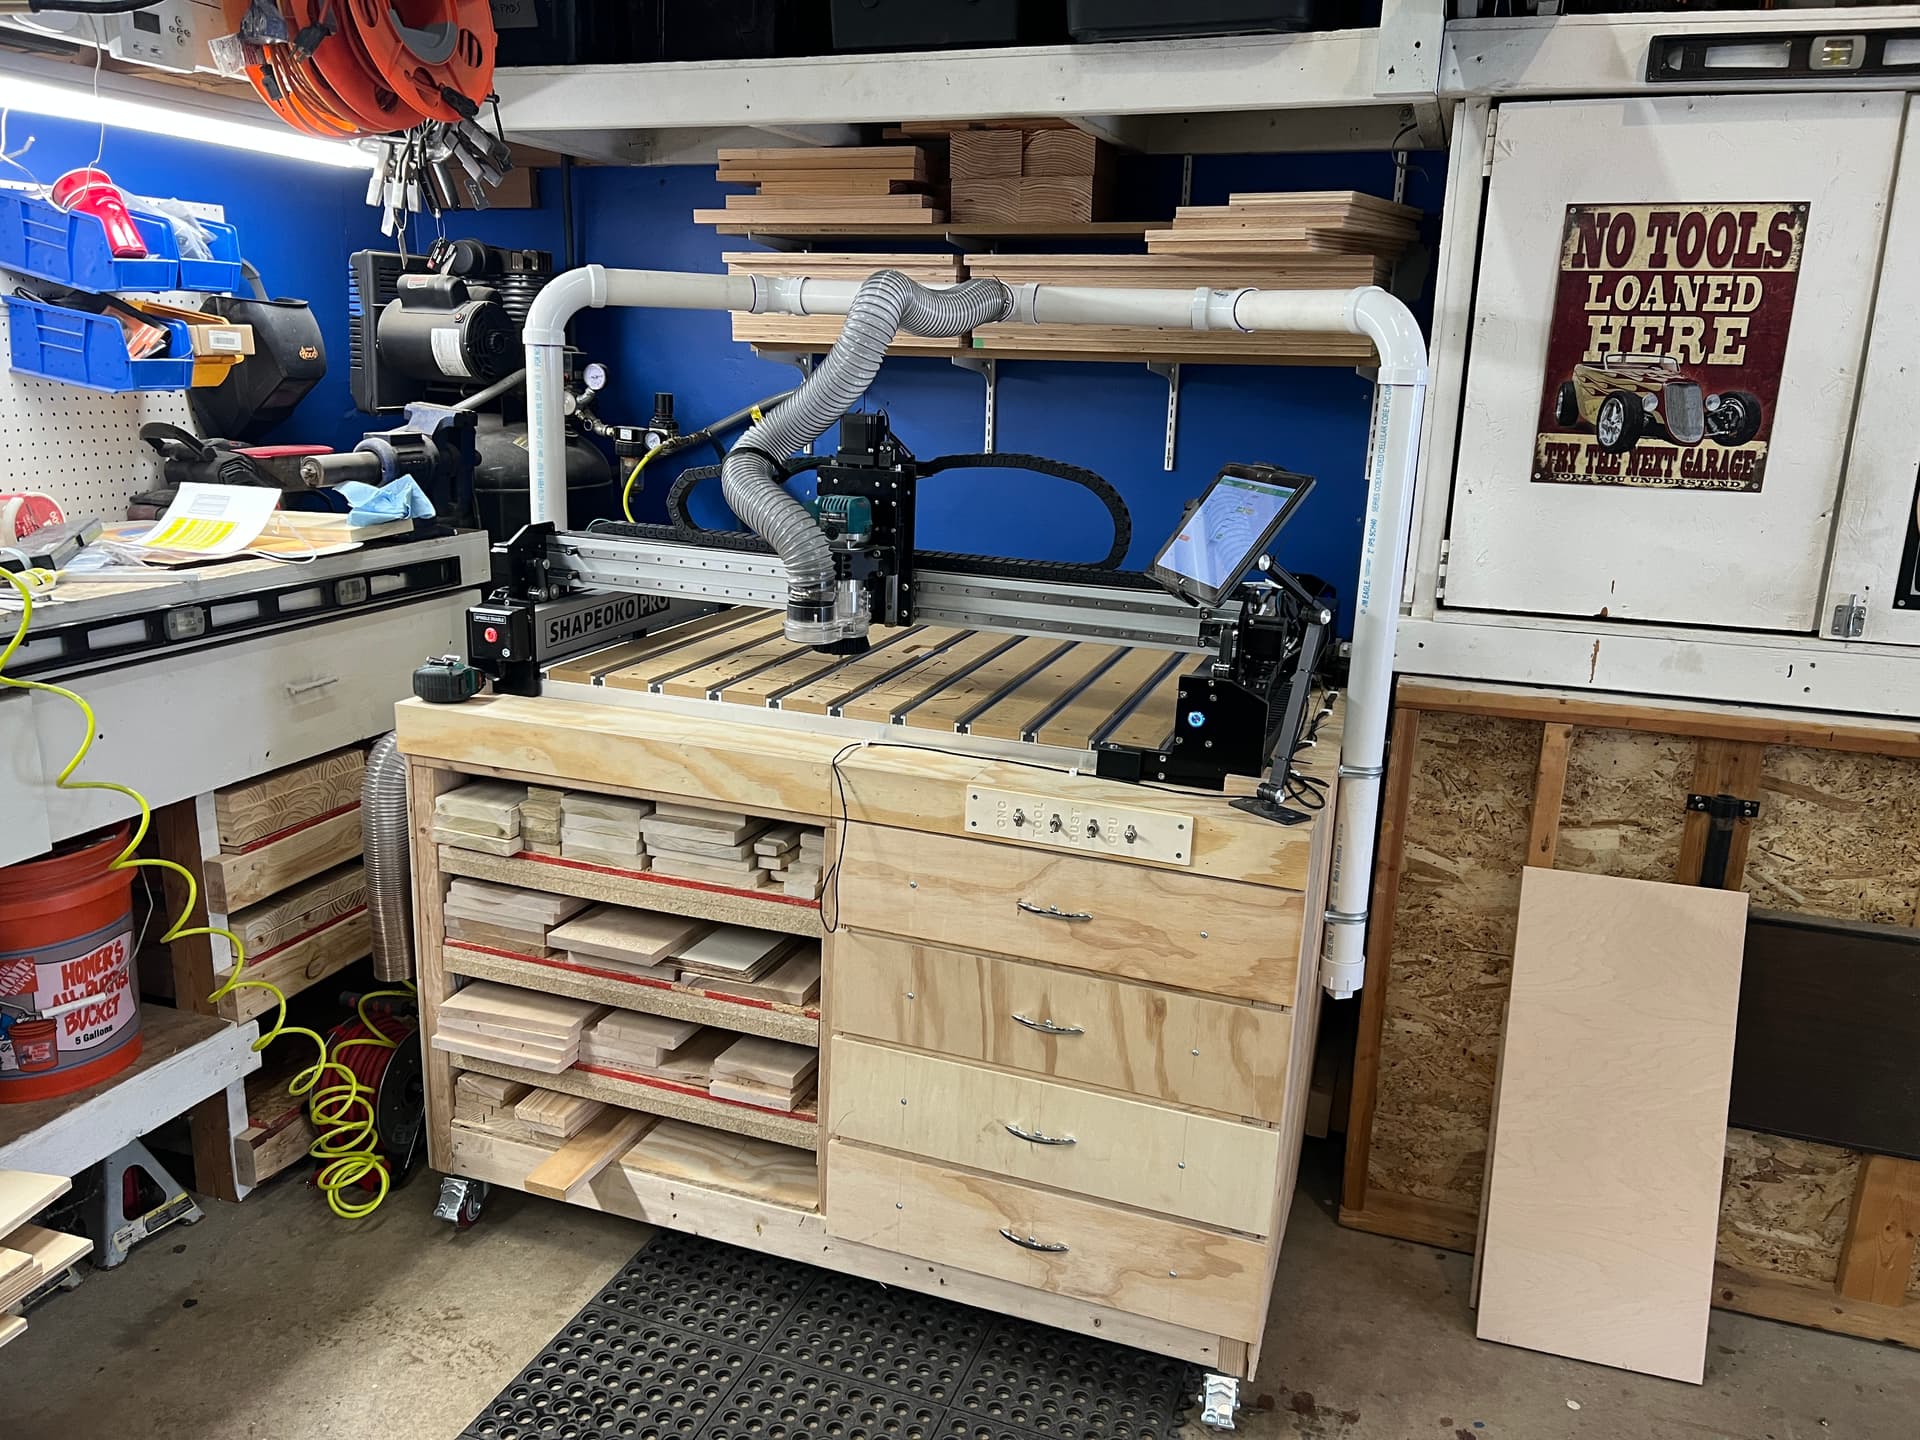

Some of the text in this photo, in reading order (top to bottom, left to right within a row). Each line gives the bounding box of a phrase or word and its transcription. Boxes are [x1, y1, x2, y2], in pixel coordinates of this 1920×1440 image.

[1571, 211, 1796, 269] NO TOOLS
[1584, 275, 1763, 312] LOANED
[1583, 316, 1750, 365] HERE
[1544, 442, 1757, 480] TRY THE NEXT GARAGE
[1599, 475, 1625, 483] YOU
[1631, 477, 1741, 489] UNDERSTAND
[550, 599, 635, 643] SHAPEOKO
[996, 800, 1008, 829] CNC
[1032, 802, 1044, 837] TOOL
[1069, 808, 1081, 844] DUST
[1107, 817, 1118, 846] CPU
[61, 940, 124, 991] HOMER'S
[64, 993, 120, 1036] BUCKET
[75, 1024, 113, 1045] 5 Gallons
